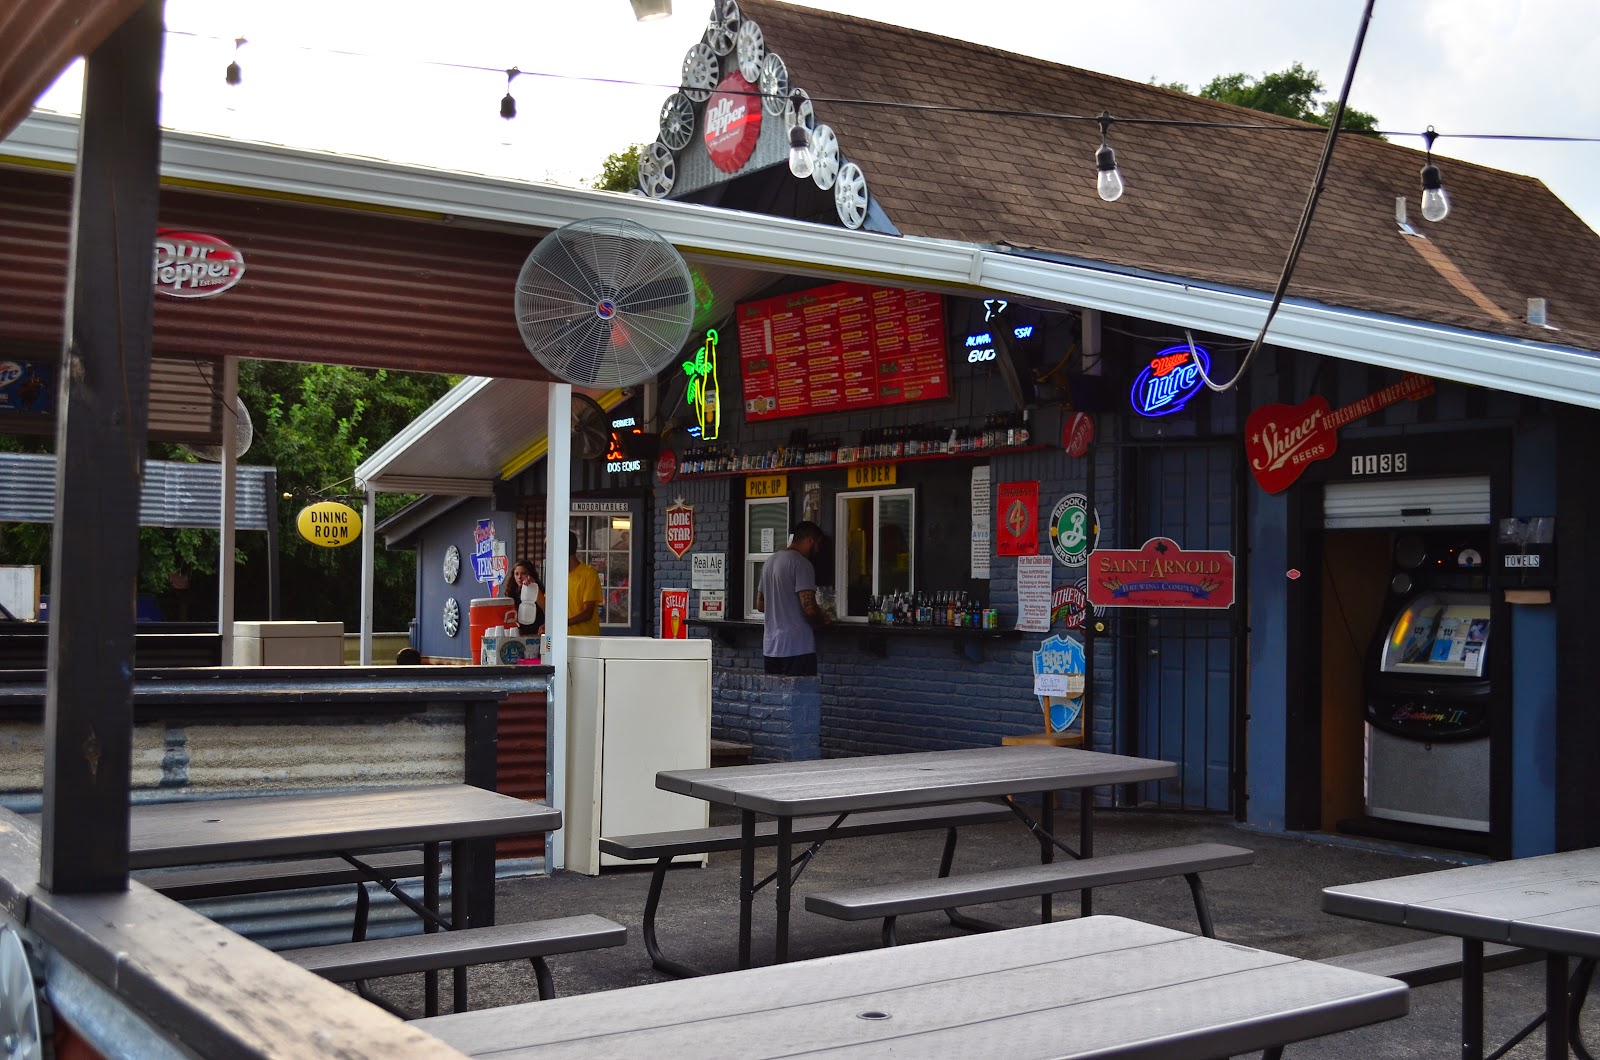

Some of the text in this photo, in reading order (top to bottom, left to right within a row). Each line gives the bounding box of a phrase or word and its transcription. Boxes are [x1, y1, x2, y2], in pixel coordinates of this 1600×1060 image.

[718, 97, 734, 117] Dr
[706, 105, 746, 137] Pepper
[968, 349, 996, 363] BUD
[1150, 352, 1190, 377] Miller
[1144, 363, 1199, 411] Lite
[1322, 374, 1433, 431] REFRESHINGLY INDEPENDENT
[1252, 409, 1324, 472] Shiner
[1292, 443, 1326, 465] BEERS
[1353, 454, 1406, 474] 1133
[607, 460, 641, 473] DOS EQUIS
[855, 465, 890, 485] ORDER
[750, 479, 782, 495] PICK-UP
[311, 511, 348, 523] DINING
[1055, 498, 1088, 518] BROOKLY
[668, 512, 690, 527] LONE
[1010, 500, 1024, 538] 4
[315, 525, 348, 538] ROOM
[668, 527, 691, 541] STAR
[694, 556, 722, 569] Real Ale
[1055, 545, 1087, 563] BREWER
[1505, 555, 1539, 567] TOWELS
[1100, 557, 1222, 579] SAINT ARNOLD
[1052, 587, 1086, 609] UTHERN
[1122, 582, 1202, 594] BREWING COMPANY
[665, 595, 686, 609] STELLA
[1067, 608, 1087, 628] STA
[1042, 650, 1072, 667] BREW
